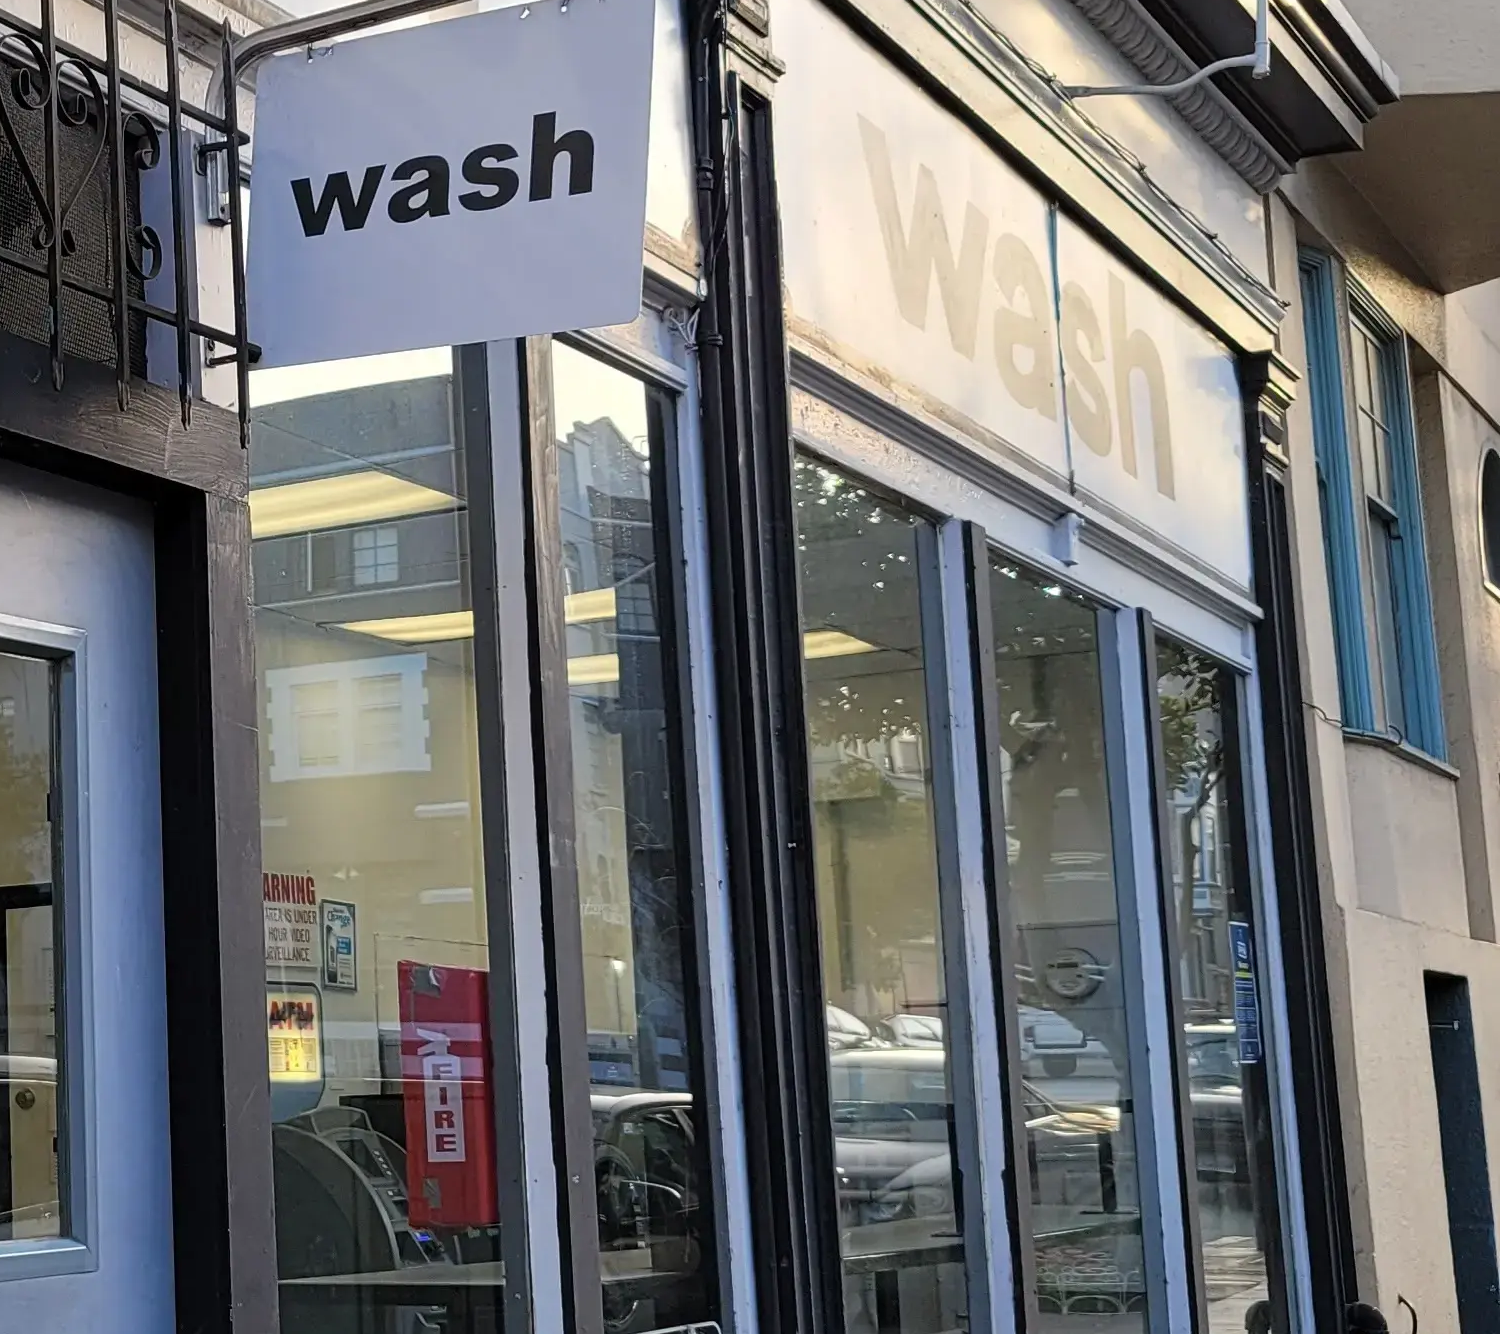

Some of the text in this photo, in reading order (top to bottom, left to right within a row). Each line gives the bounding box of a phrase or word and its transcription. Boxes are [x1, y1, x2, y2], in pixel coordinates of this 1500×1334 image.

[292, 111, 594, 237] wash
[857, 112, 1175, 501] wash
[262, 872, 317, 906] ARNING
[284, 908, 293, 923] IS
[293, 910, 318, 925] UNDER
[268, 926, 310, 943] HOUR VIDEO
[269, 1000, 314, 1031] ATM
[431, 1063, 457, 1153] FIRE
